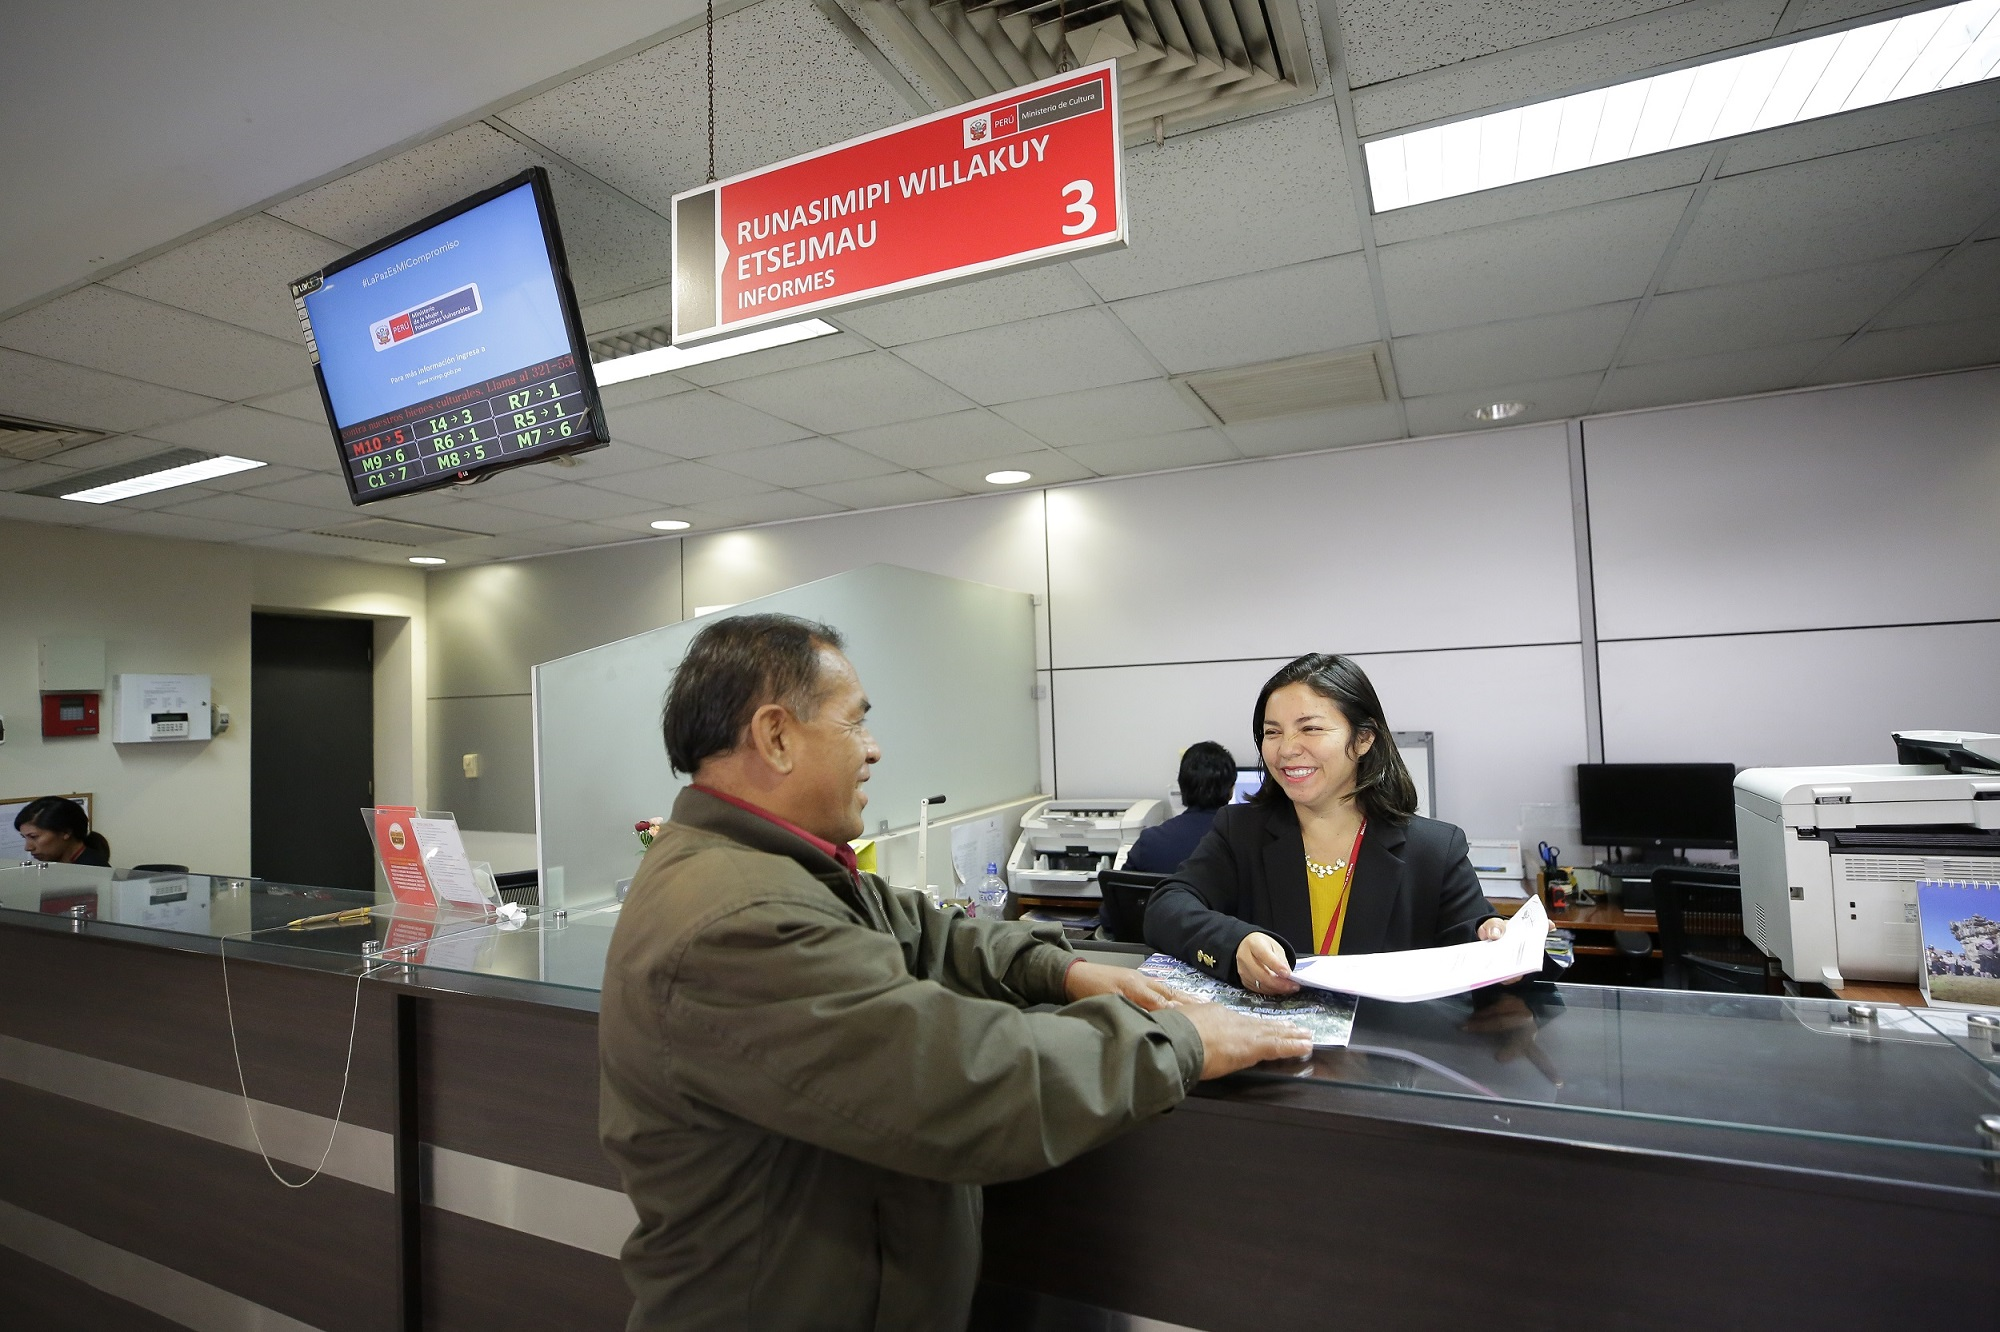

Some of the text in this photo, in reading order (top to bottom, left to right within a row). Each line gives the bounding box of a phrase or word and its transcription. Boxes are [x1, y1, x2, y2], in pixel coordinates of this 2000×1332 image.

[1021, 93, 1095, 120] Ministerio de Cultura
[994, 114, 1015, 129] PERÚ
[737, 134, 1050, 245] RUNASIMIPI WILLAKUY
[1061, 179, 1097, 236] 3
[737, 219, 878, 281] ETSEJMAU
[738, 268, 835, 309] INFORMES
[411, 306, 435, 319] Ministerio
[414, 305, 471, 332] Poblaciones Vulnerables
[425, 311, 440, 321] Mujer
[393, 321, 410, 334] PERÚ
[390, 375, 404, 385] Para
[405, 369, 418, 379] más
[418, 357, 456, 375] información
[456, 348, 480, 361] ingresa
[342, 425, 366, 439] contra
[368, 412, 404, 430] nuestros
[405, 402, 434, 418] bienes
[486, 377, 516, 392] Llama
[520, 370, 529, 382] al
[508, 382, 560, 410] R7 1
[430, 408, 473, 434] I4 3
[513, 402, 566, 430] R5 1
[353, 429, 405, 456] M10 5
[433, 427, 480, 452] R6 1
[517, 420, 572, 449] M7 6
[362, 448, 405, 472] M9 6
[437, 445, 485, 470] M8 5
[368, 466, 407, 489] C1 7
